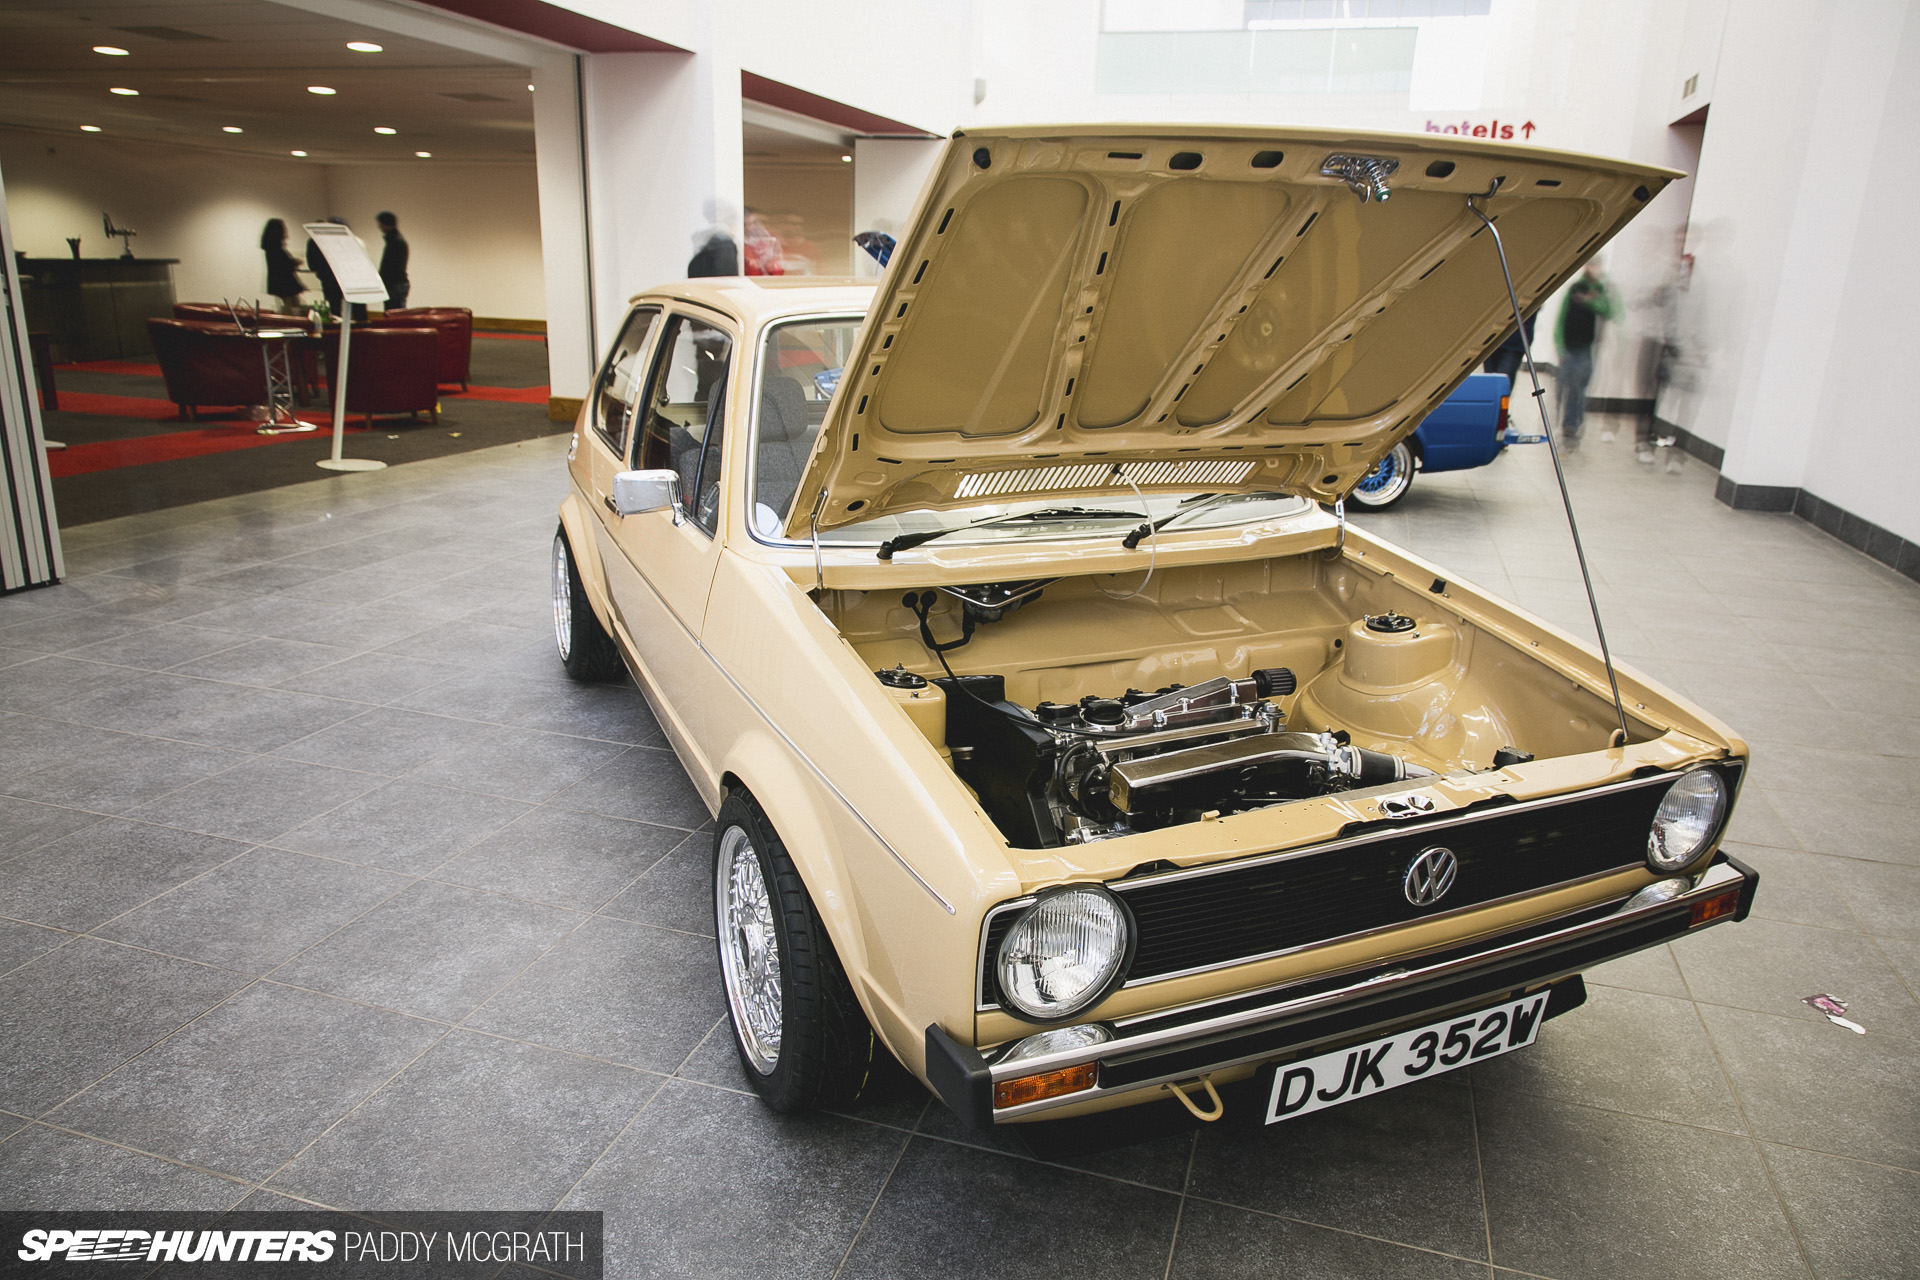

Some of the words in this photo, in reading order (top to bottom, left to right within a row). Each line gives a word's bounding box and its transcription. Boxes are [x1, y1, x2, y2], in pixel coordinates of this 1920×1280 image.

[1425, 120, 1514, 139] hotels
[1406, 848, 1457, 905] VW
[1275, 1041, 1394, 1117] DJK
[1403, 998, 1544, 1077] 352W
